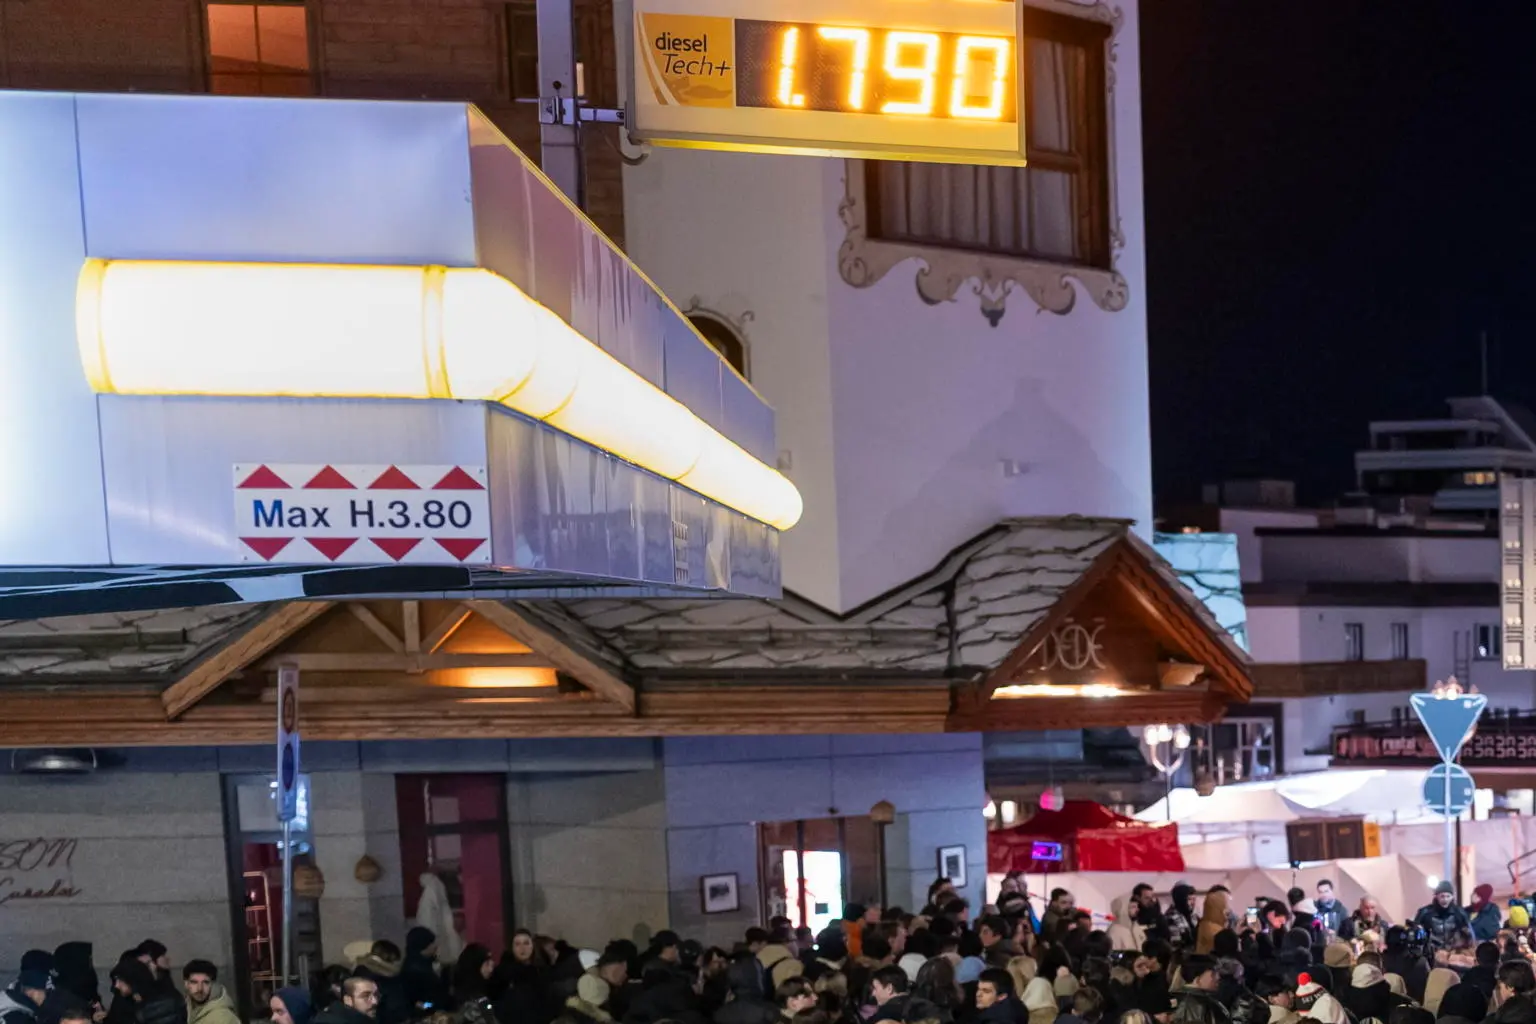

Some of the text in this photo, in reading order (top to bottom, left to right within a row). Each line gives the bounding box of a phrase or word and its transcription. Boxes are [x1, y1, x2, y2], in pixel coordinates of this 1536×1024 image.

[655, 32, 707, 53] diesel
[663, 53, 731, 77] Tech+
[777, 26, 1010, 119] 1.790
[252, 499, 472, 529] Max H.3.80
